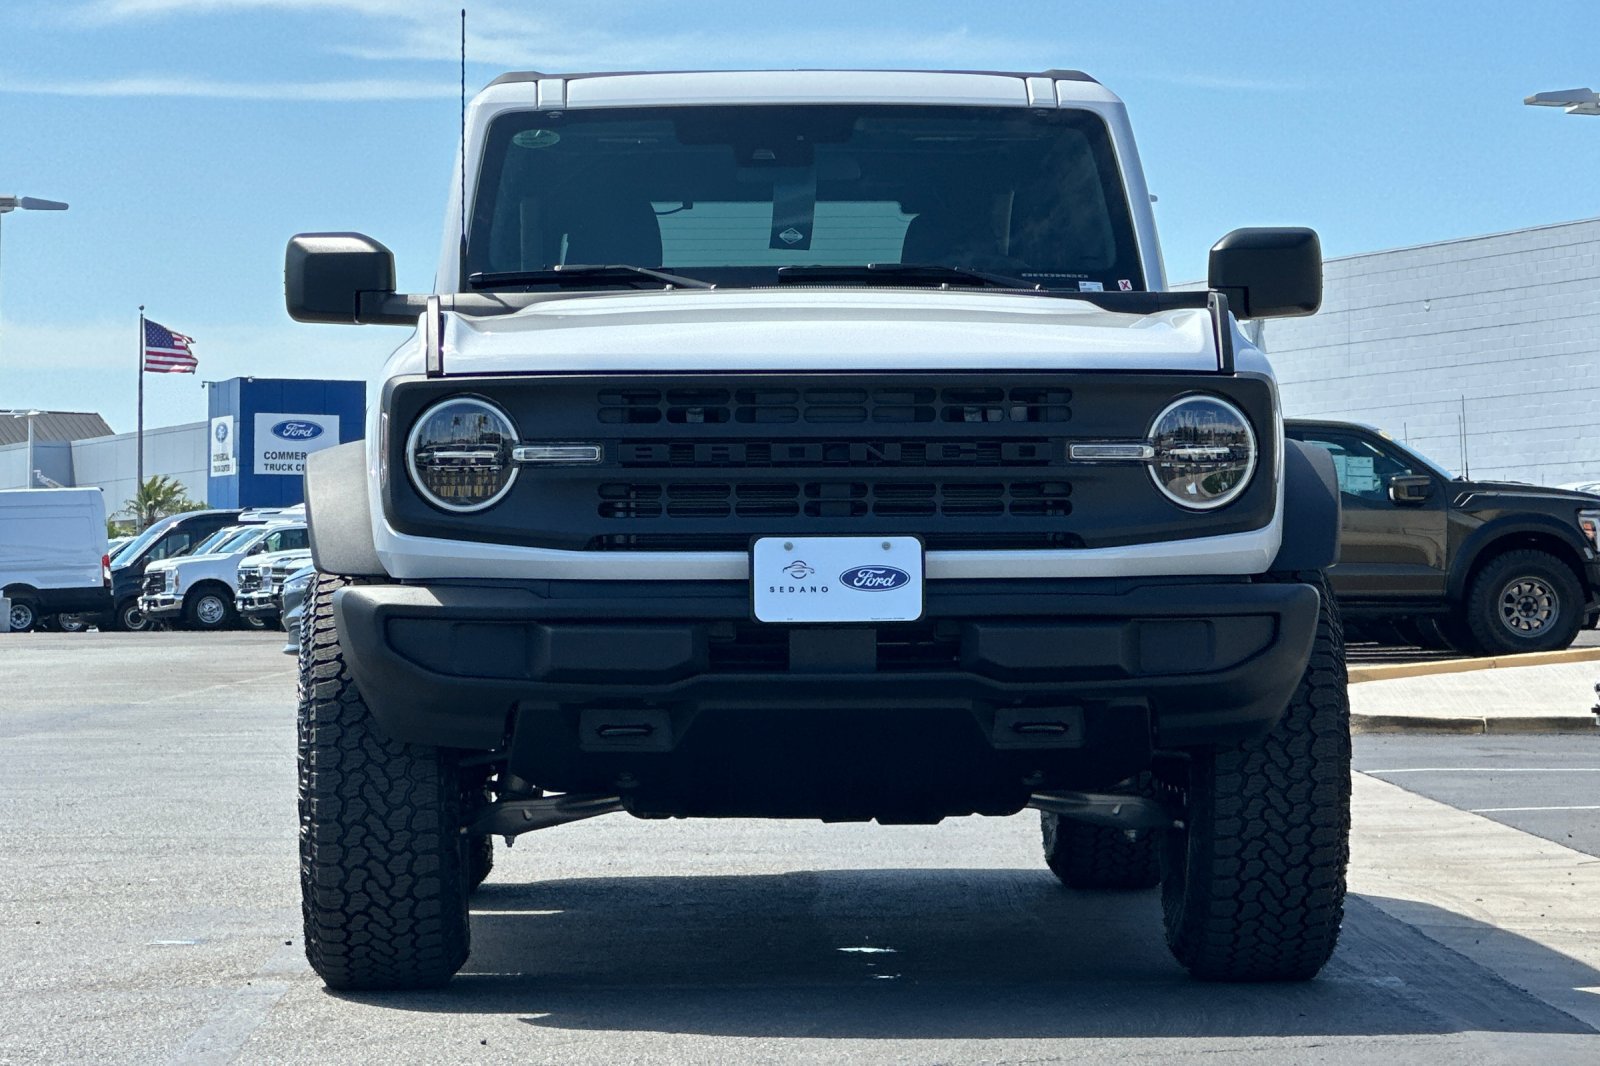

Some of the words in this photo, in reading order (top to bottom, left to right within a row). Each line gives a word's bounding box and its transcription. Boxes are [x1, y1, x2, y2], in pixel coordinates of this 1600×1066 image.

[282, 422, 313, 438] Ford
[618, 442, 1053, 463] BRONCO
[263, 463, 293, 471] TRUCK
[853, 568, 896, 588] Ford
